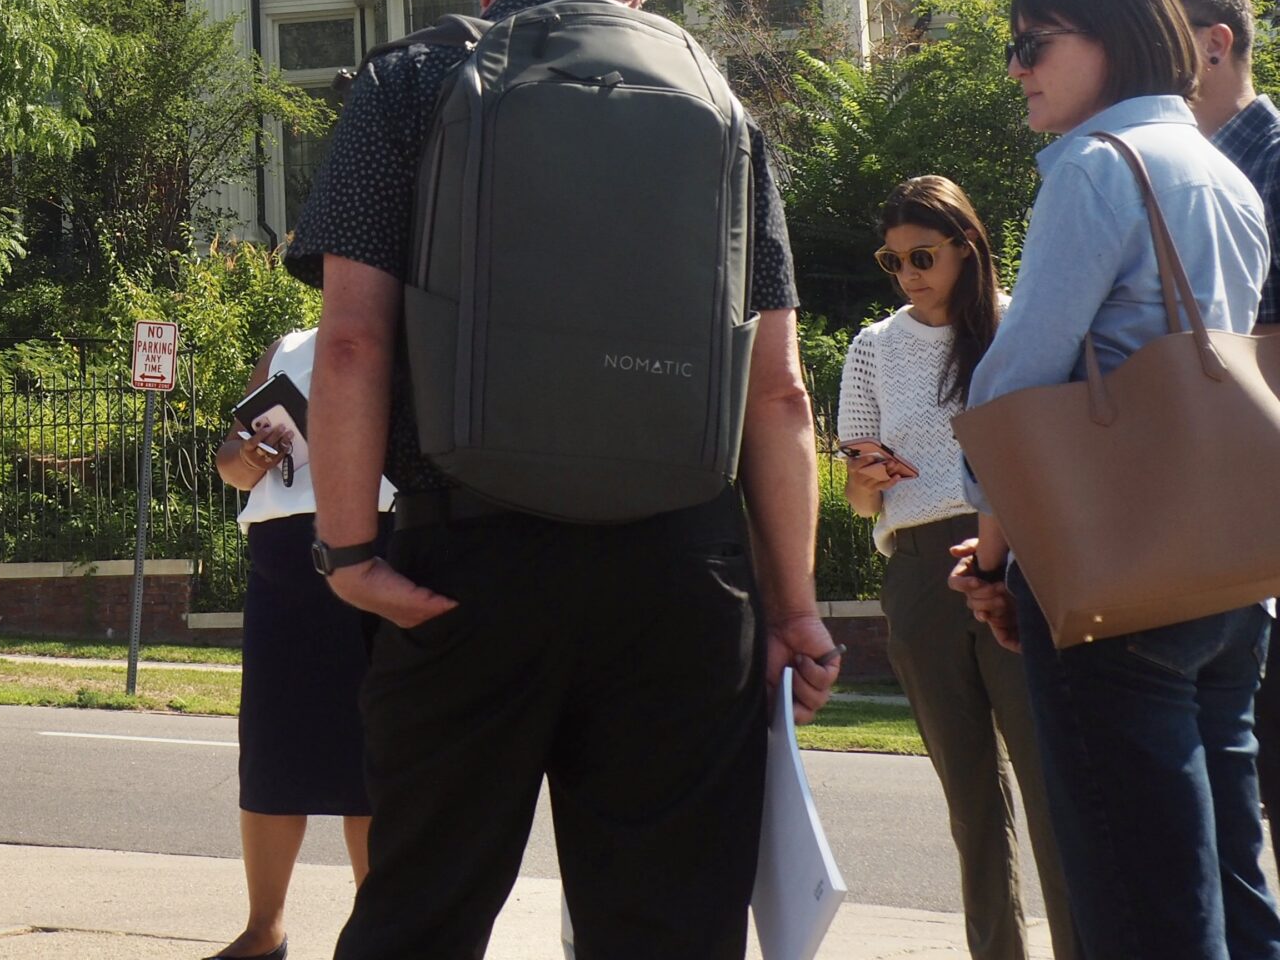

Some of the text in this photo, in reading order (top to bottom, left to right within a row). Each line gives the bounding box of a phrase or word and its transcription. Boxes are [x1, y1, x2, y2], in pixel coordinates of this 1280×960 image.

[148, 326, 163, 338] NO
[137, 340, 172, 355] PARKING
[145, 354, 161, 363] ANY
[144, 364, 162, 373] TIME
[604, 354, 693, 378] NOMATIC
